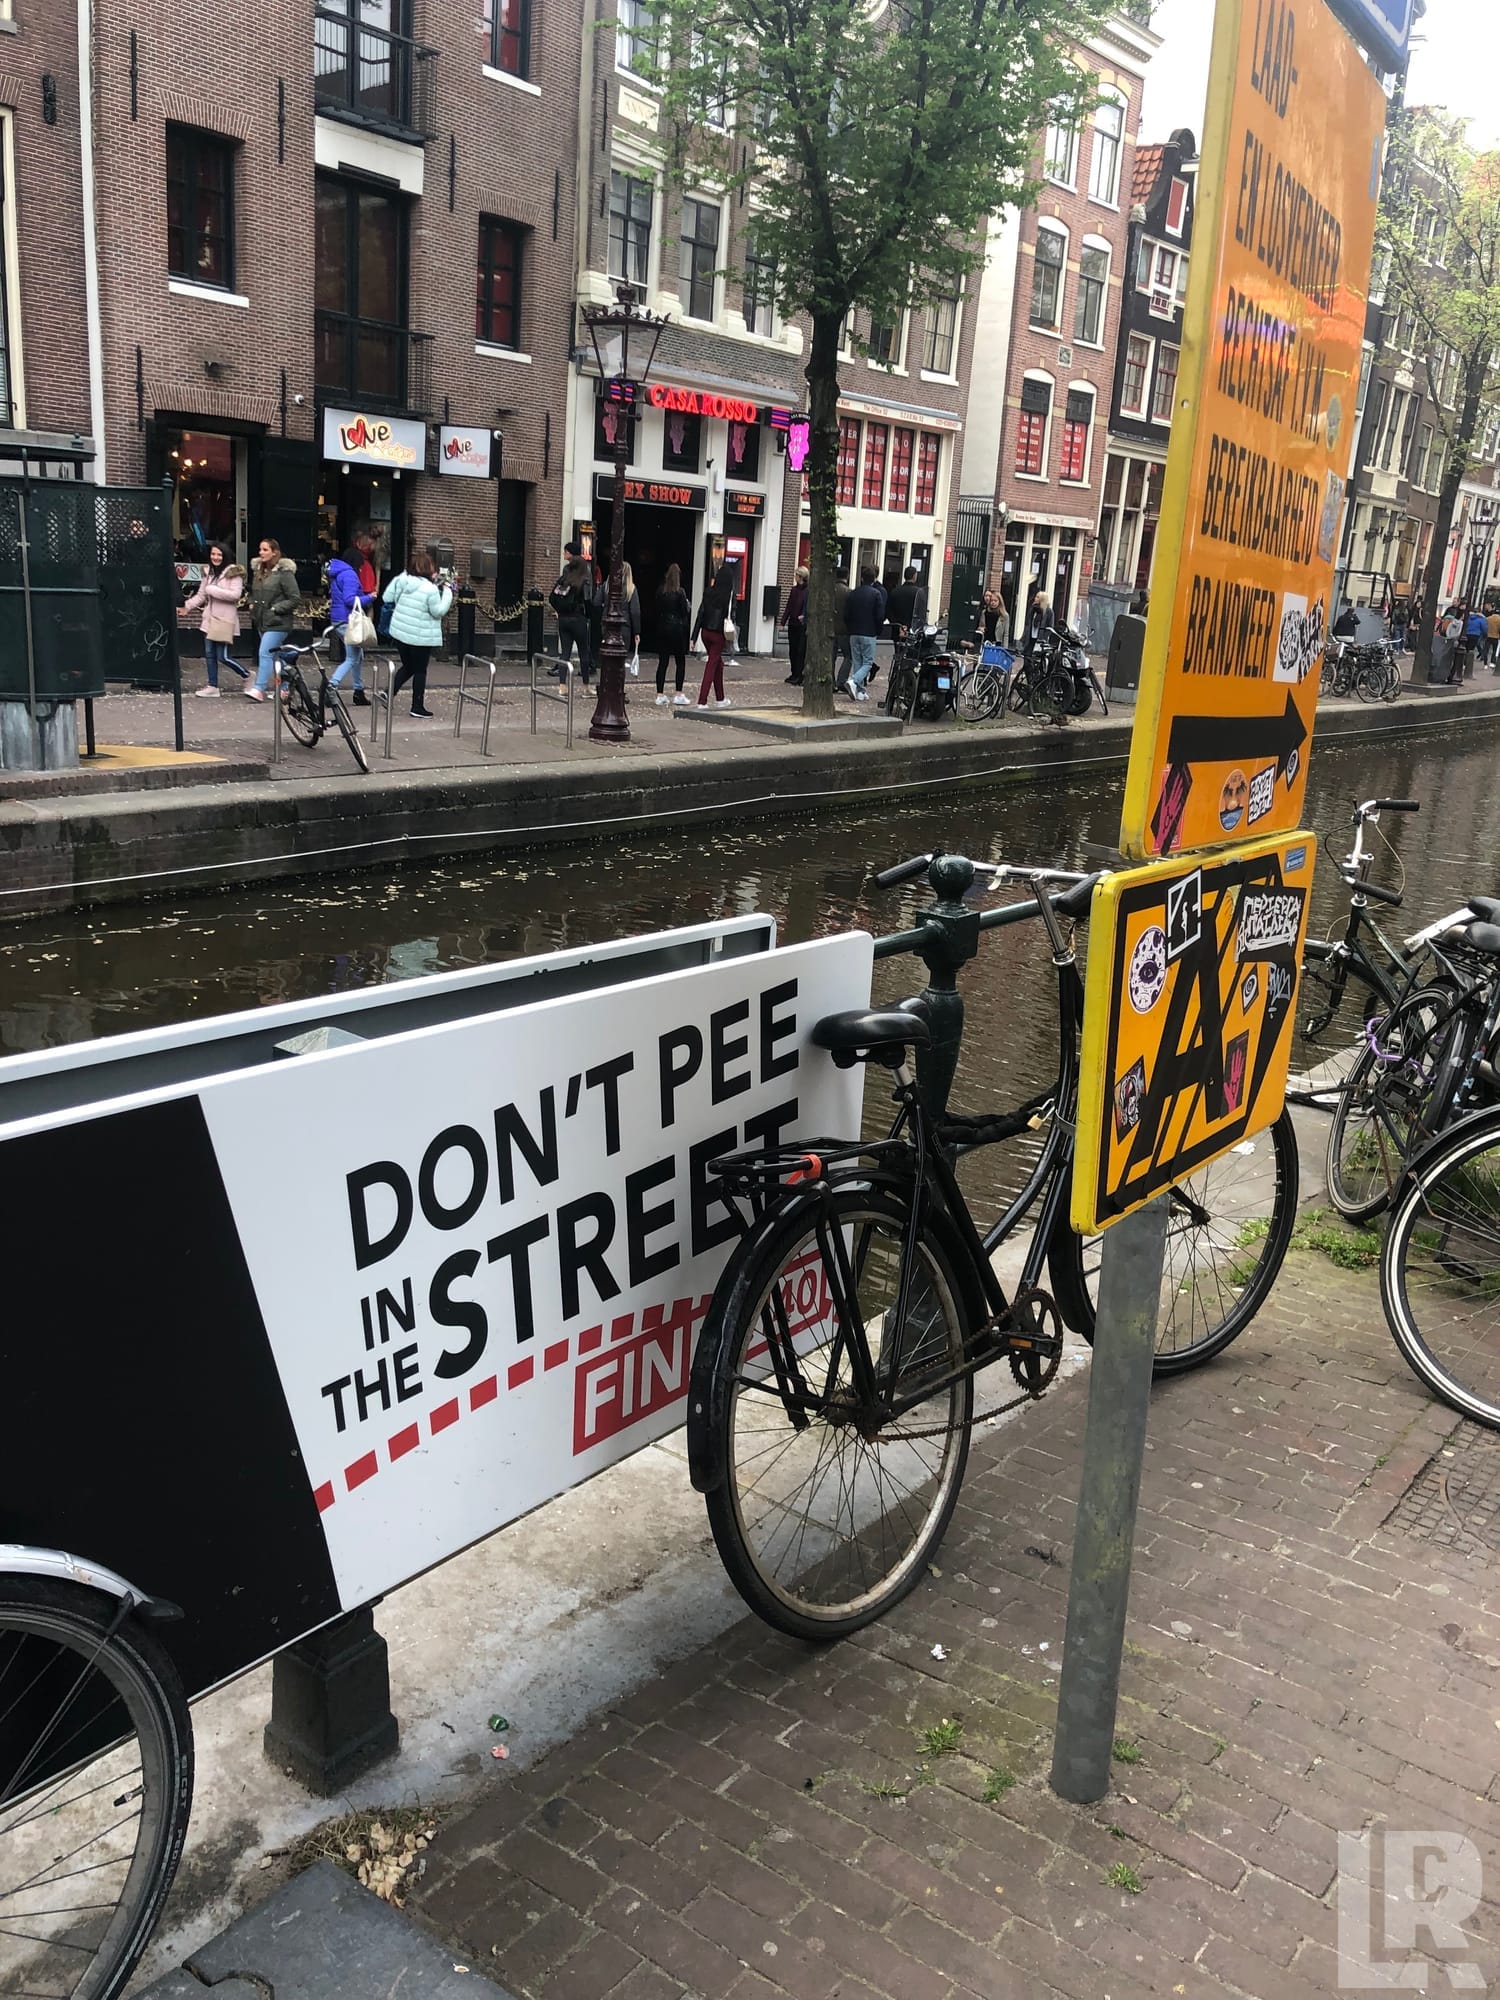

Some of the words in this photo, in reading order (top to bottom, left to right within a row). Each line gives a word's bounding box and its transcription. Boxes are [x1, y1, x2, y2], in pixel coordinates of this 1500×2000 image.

[1236, 128, 1263, 253] EN
[1257, 152, 1342, 318] LOSVERKEER
[650, 384, 699, 414] CASA
[700, 393, 758, 424] ROSSO
[1218, 285, 1296, 425] RECHTSAF
[624, 481, 645, 500] EX
[649, 484, 692, 505] SHOW
[1201, 433, 1319, 566] BEREIKBAARHEID
[1182, 574, 1276, 679] BRANDWEER
[346, 1050, 634, 1271] DON'T
[658, 977, 799, 1129] PEE
[429, 1097, 799, 1380] STREET
[360, 1277, 416, 1352] IN
[321, 1342, 424, 1434] THE
[584, 1316, 701, 1439] FIN
